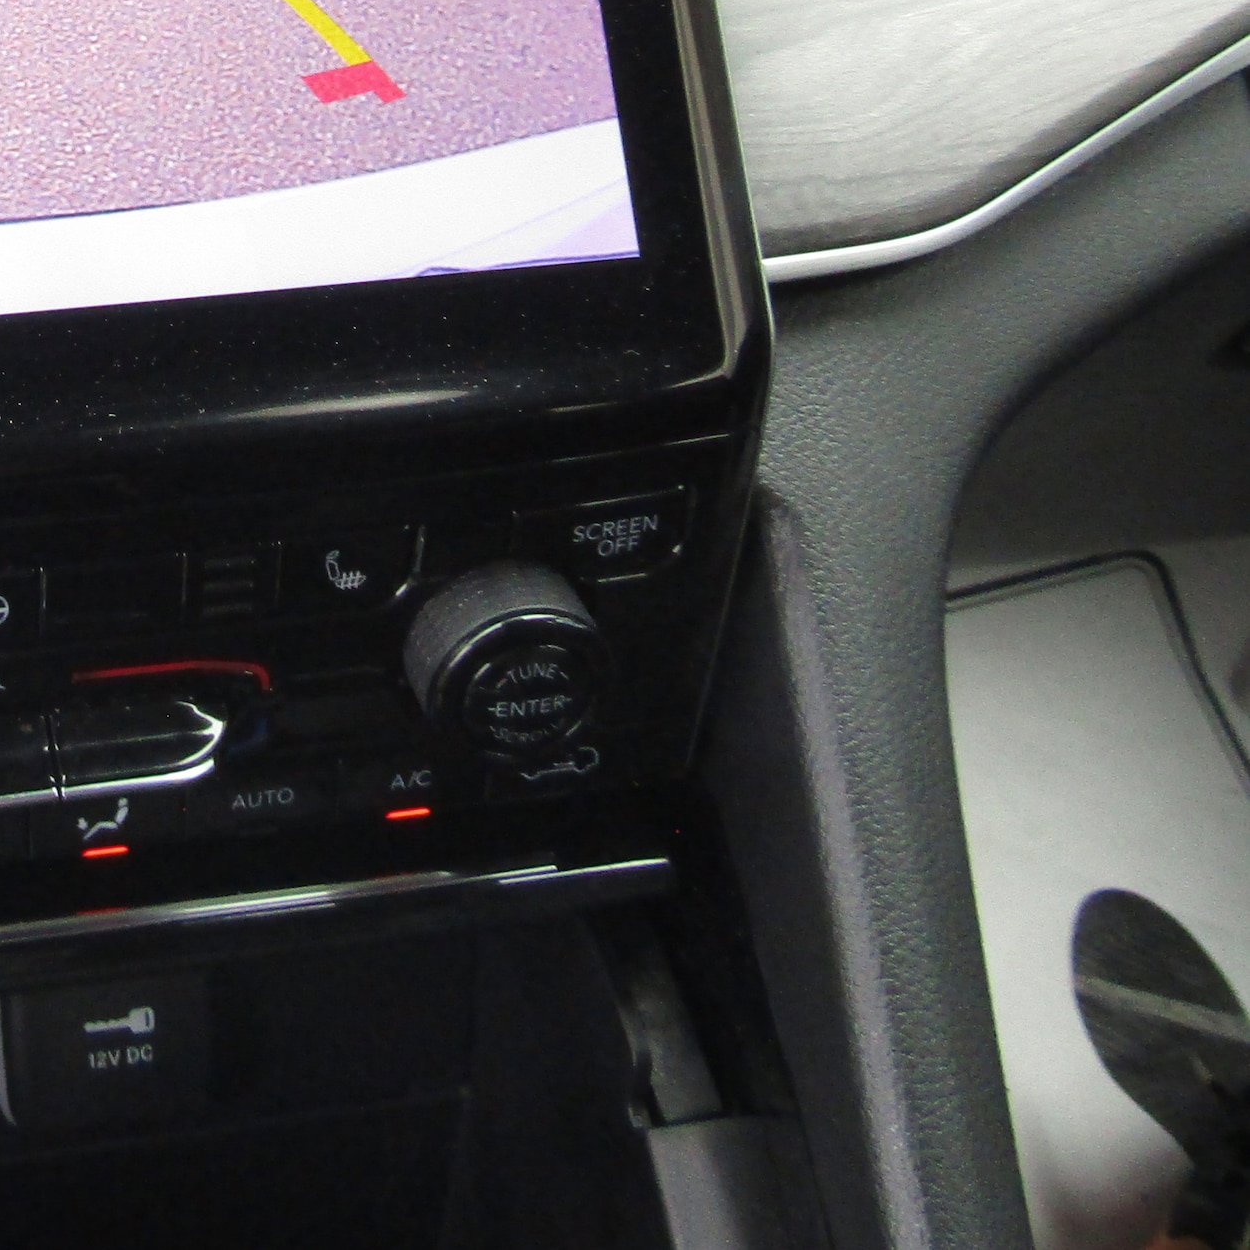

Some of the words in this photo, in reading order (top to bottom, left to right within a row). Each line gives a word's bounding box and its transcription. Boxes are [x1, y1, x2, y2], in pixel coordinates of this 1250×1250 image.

[572, 514, 658, 543] SCREEN
[597, 535, 640, 557] OFF
[506, 661, 560, 684] TUNE
[495, 694, 567, 718] ENTER
[390, 769, 432, 790] A/C
[231, 787, 295, 811] AUTO
